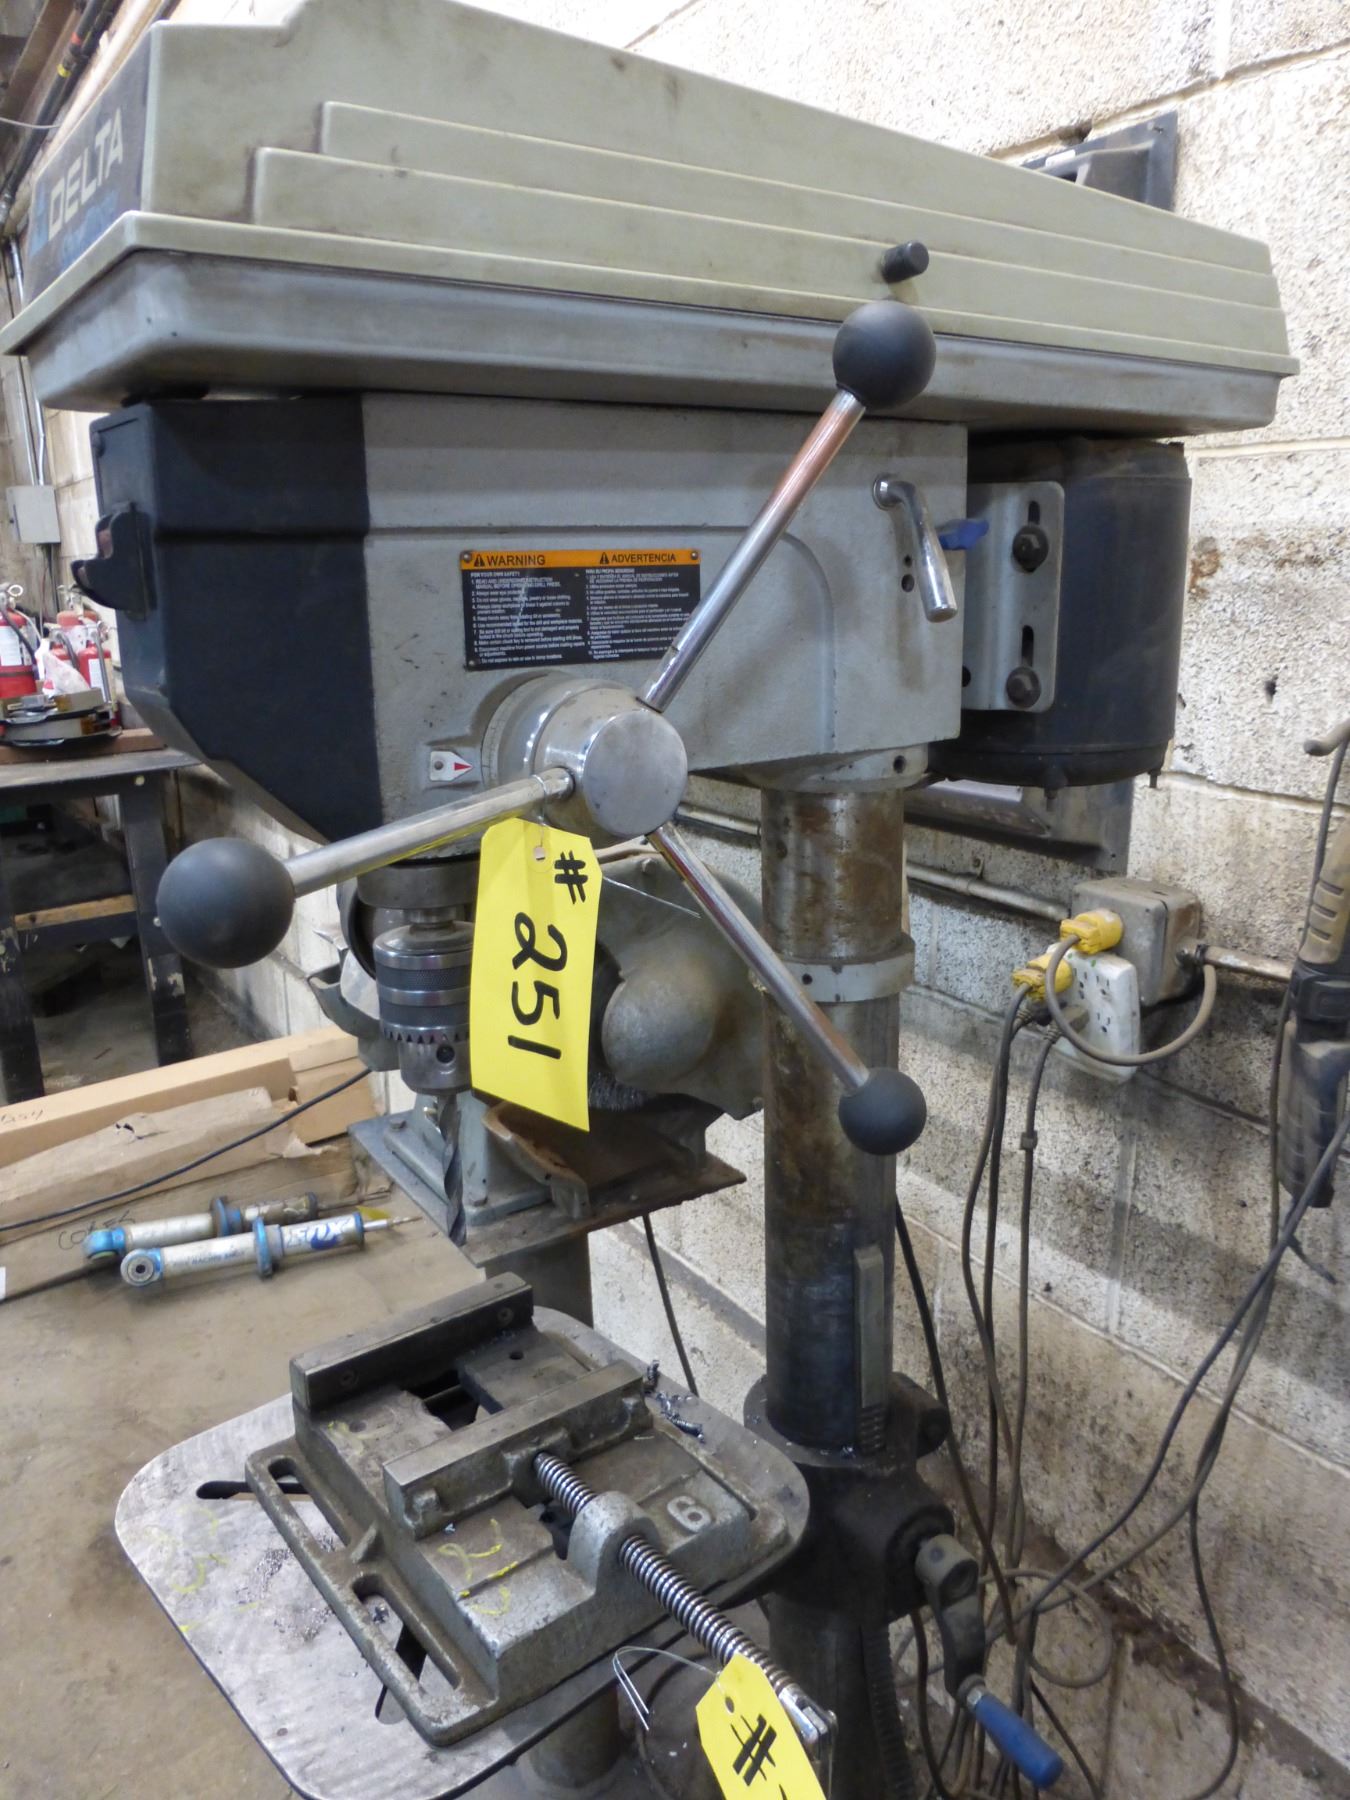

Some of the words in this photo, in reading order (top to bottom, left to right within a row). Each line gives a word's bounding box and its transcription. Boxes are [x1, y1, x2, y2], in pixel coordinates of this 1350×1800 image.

[48, 107, 123, 241] DELTA
[487, 554, 546, 566] WARNING
[611, 552, 677, 564] ADVERTENCIA
